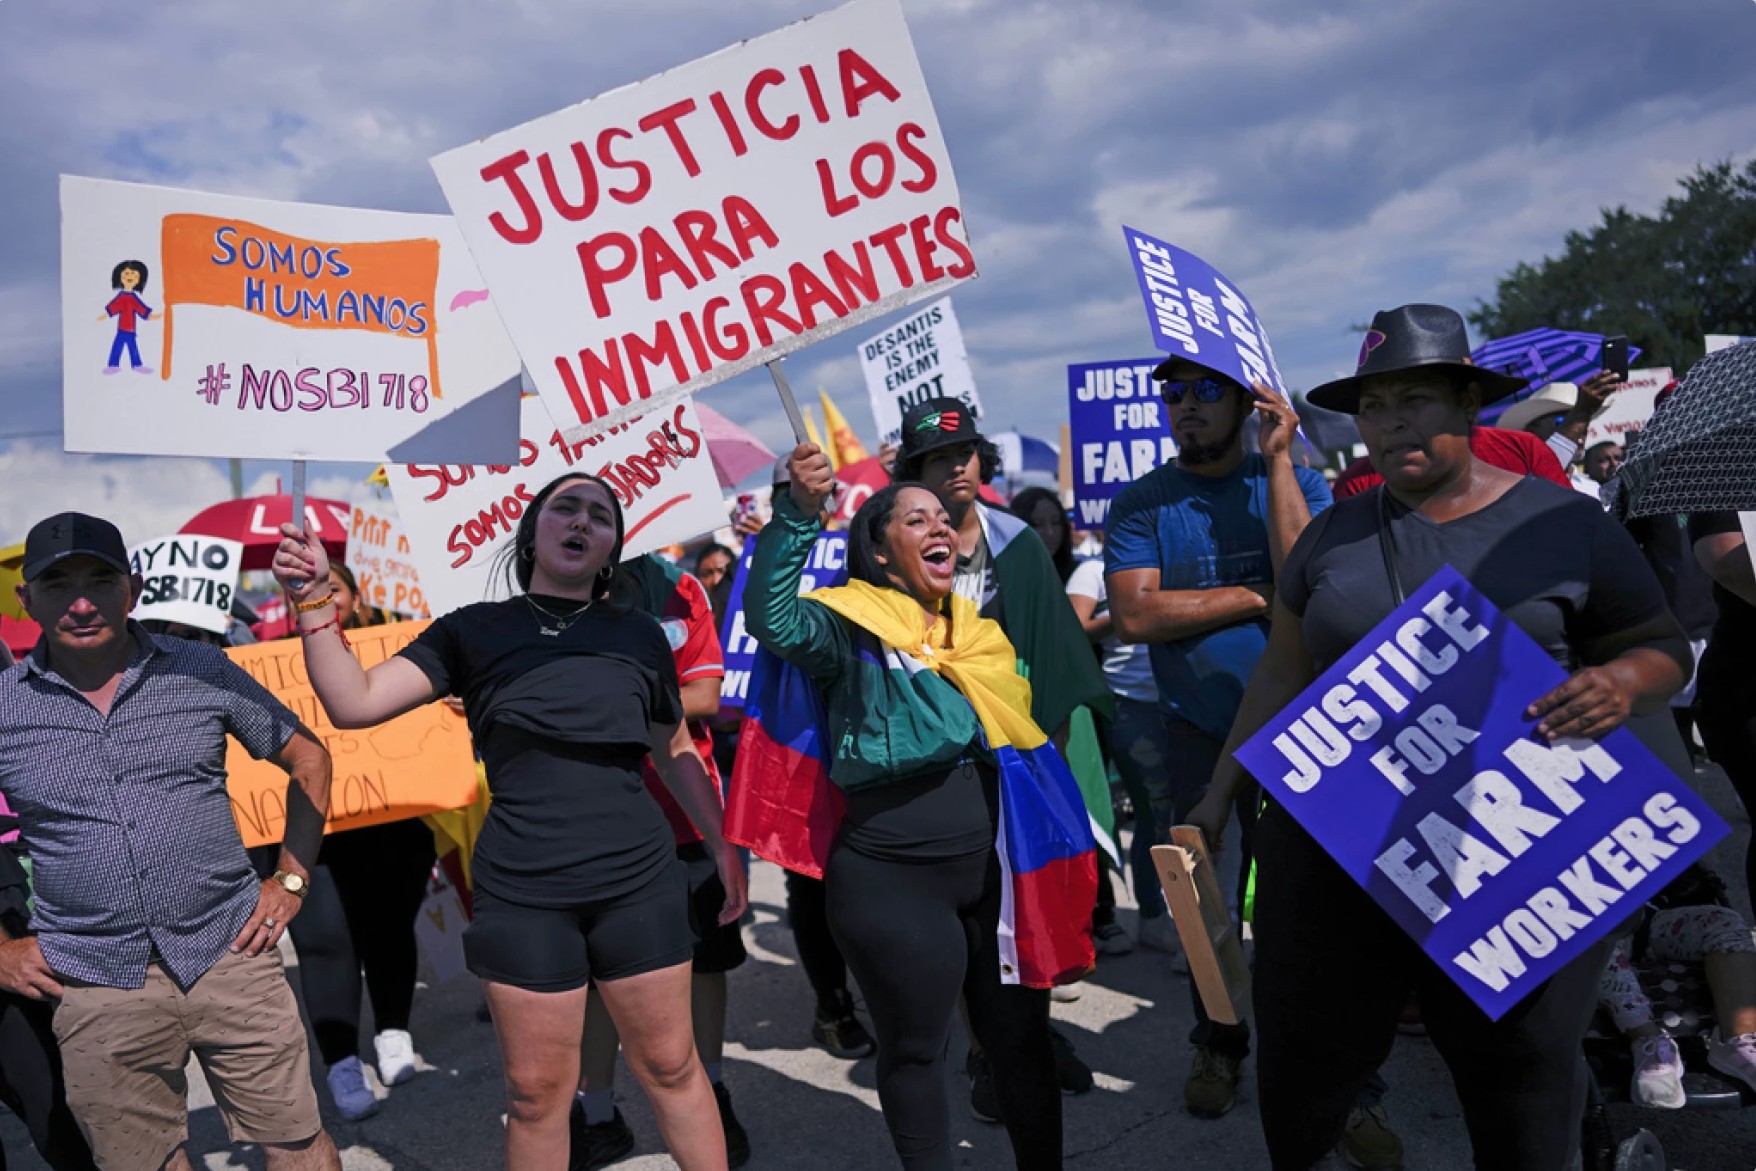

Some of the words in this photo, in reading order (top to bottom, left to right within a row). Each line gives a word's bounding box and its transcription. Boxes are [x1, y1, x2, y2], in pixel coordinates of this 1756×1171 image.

[480, 48, 901, 244] JUSTICIA
[576, 195, 779, 318] PARA
[816, 122, 937, 217] LOS
[212, 226, 351, 279] SOMOS
[244, 276, 427, 334] HUMANOS
[556, 206, 976, 424] INMIGRANTES
[1134, 236, 1199, 354] JUSTICE
[1187, 287, 1225, 338] FOR
[865, 306, 943, 361] DESANTIS
[885, 350, 901, 371] IS
[906, 331, 936, 359] THE
[885, 348, 940, 392] ENEMY
[897, 373, 944, 414] NOT
[1076, 364, 1167, 401] JUSTI
[1114, 401, 1161, 431] FOR
[1272, 590, 1490, 793] JUSTICE
[1369, 703, 1481, 796] FOR
[1373, 737, 1623, 924] FARM
[1452, 792, 1701, 993] WORKERS
